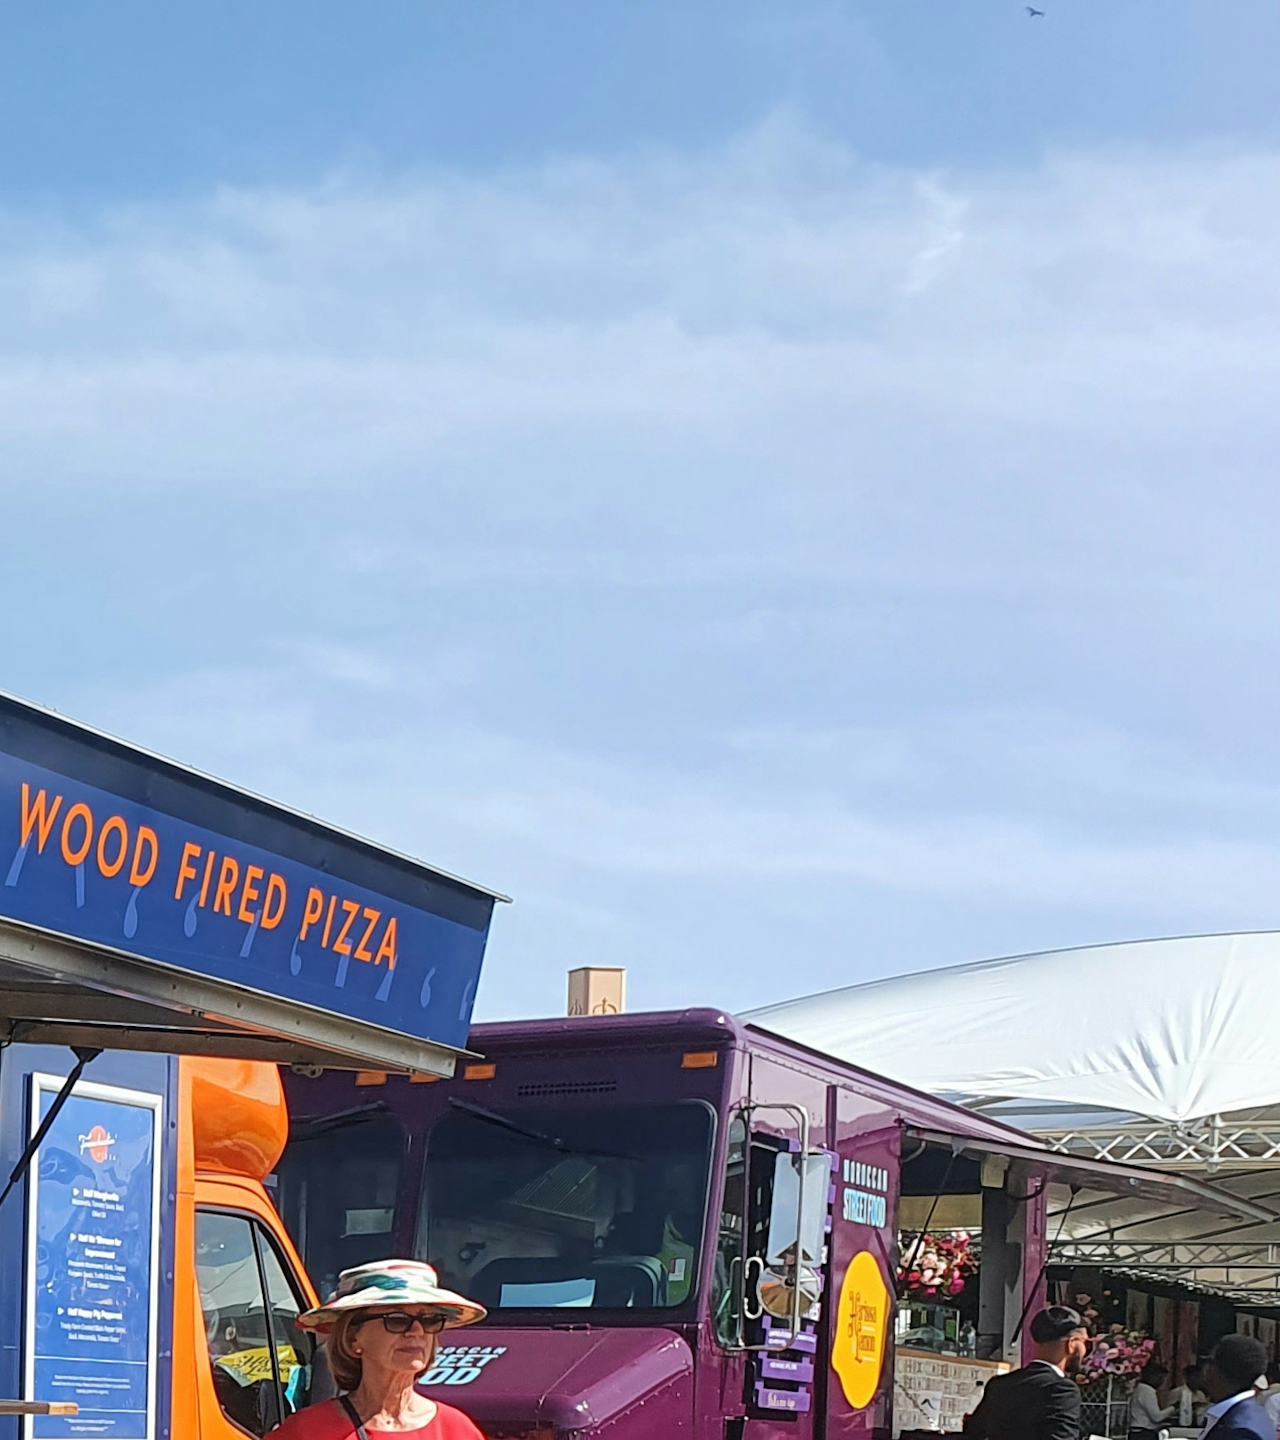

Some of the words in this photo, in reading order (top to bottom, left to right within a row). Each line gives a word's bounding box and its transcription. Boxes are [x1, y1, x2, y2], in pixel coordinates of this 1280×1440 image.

[20, 783, 159, 888] WOOD
[174, 841, 288, 931] FIRED
[298, 886, 399, 970] PIZZA
